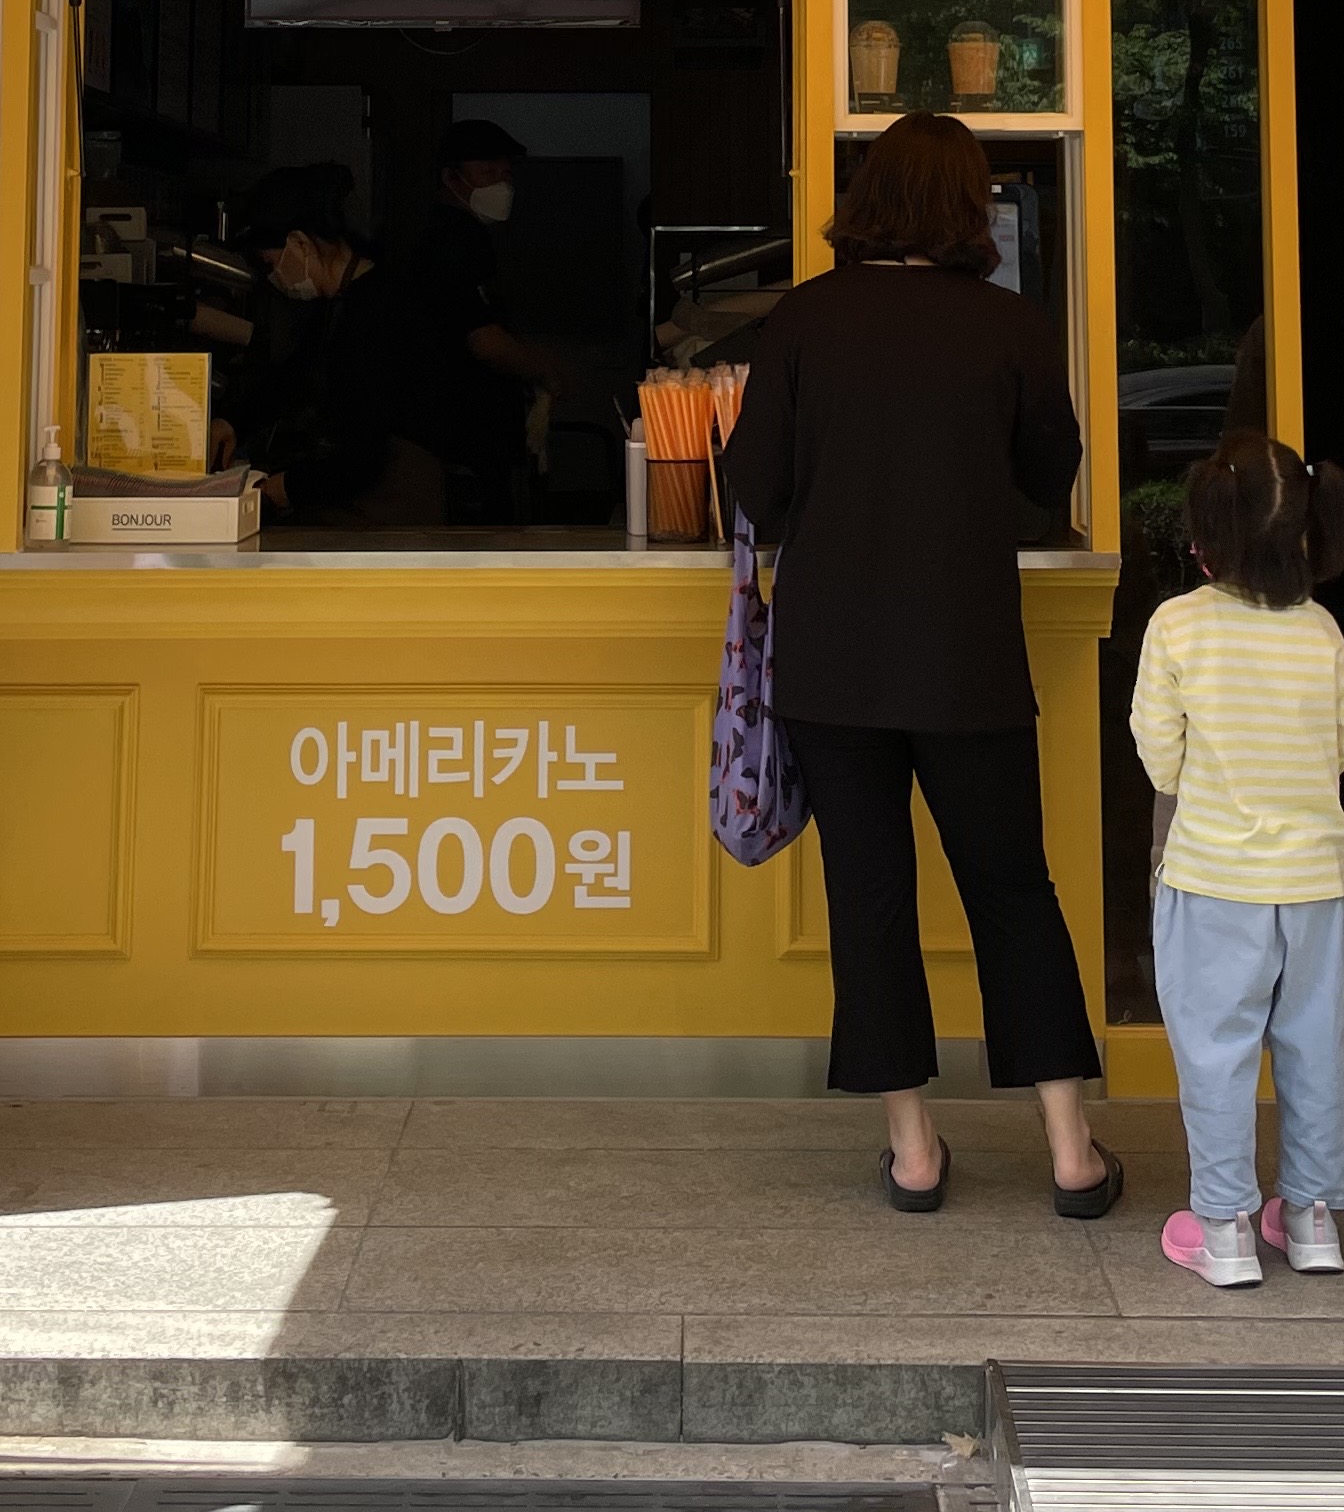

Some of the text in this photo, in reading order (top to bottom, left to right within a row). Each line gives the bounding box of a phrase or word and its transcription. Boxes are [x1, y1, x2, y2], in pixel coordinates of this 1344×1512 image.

[112, 513, 172, 527] BONJOUR
[289, 720, 625, 800] 아메리카노
[281, 816, 632, 928] 1,500원
